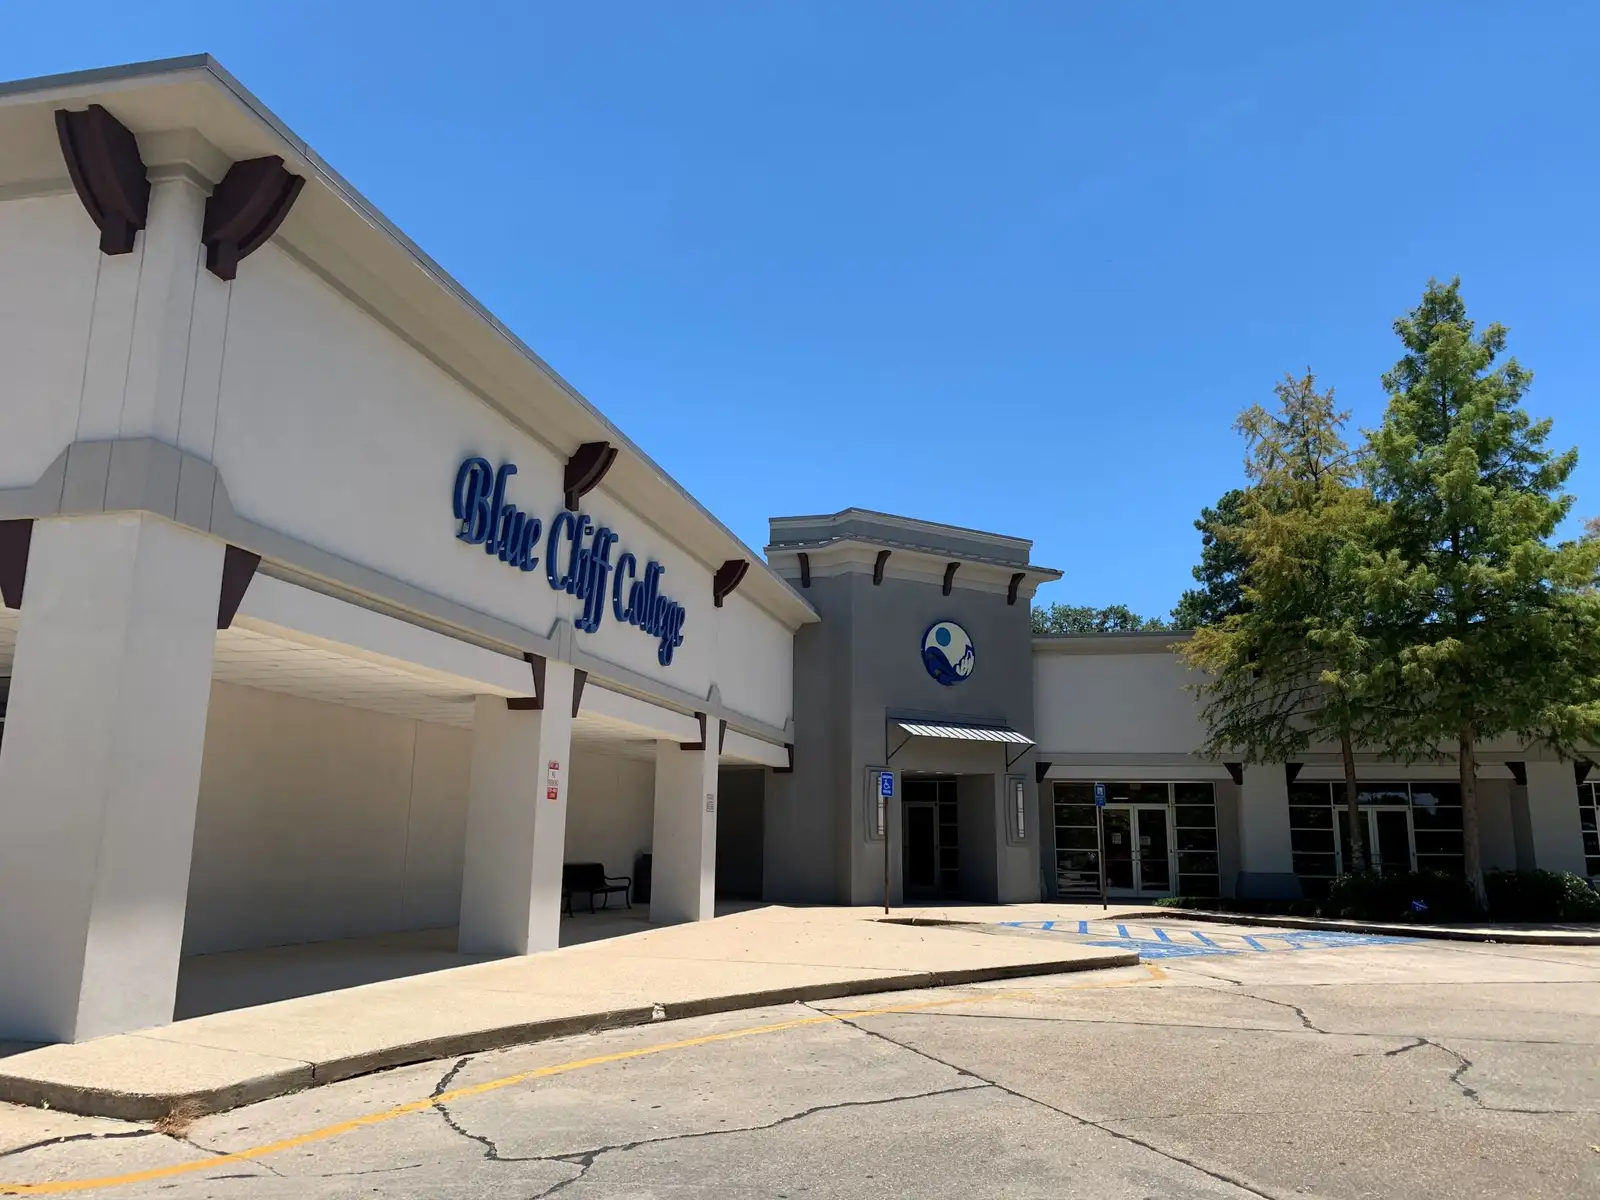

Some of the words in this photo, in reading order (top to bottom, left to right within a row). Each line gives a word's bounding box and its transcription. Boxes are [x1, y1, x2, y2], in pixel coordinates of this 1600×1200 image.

[453, 457, 542, 572] Blue
[546, 511, 619, 633] Cliff
[612, 553, 686, 666] College
